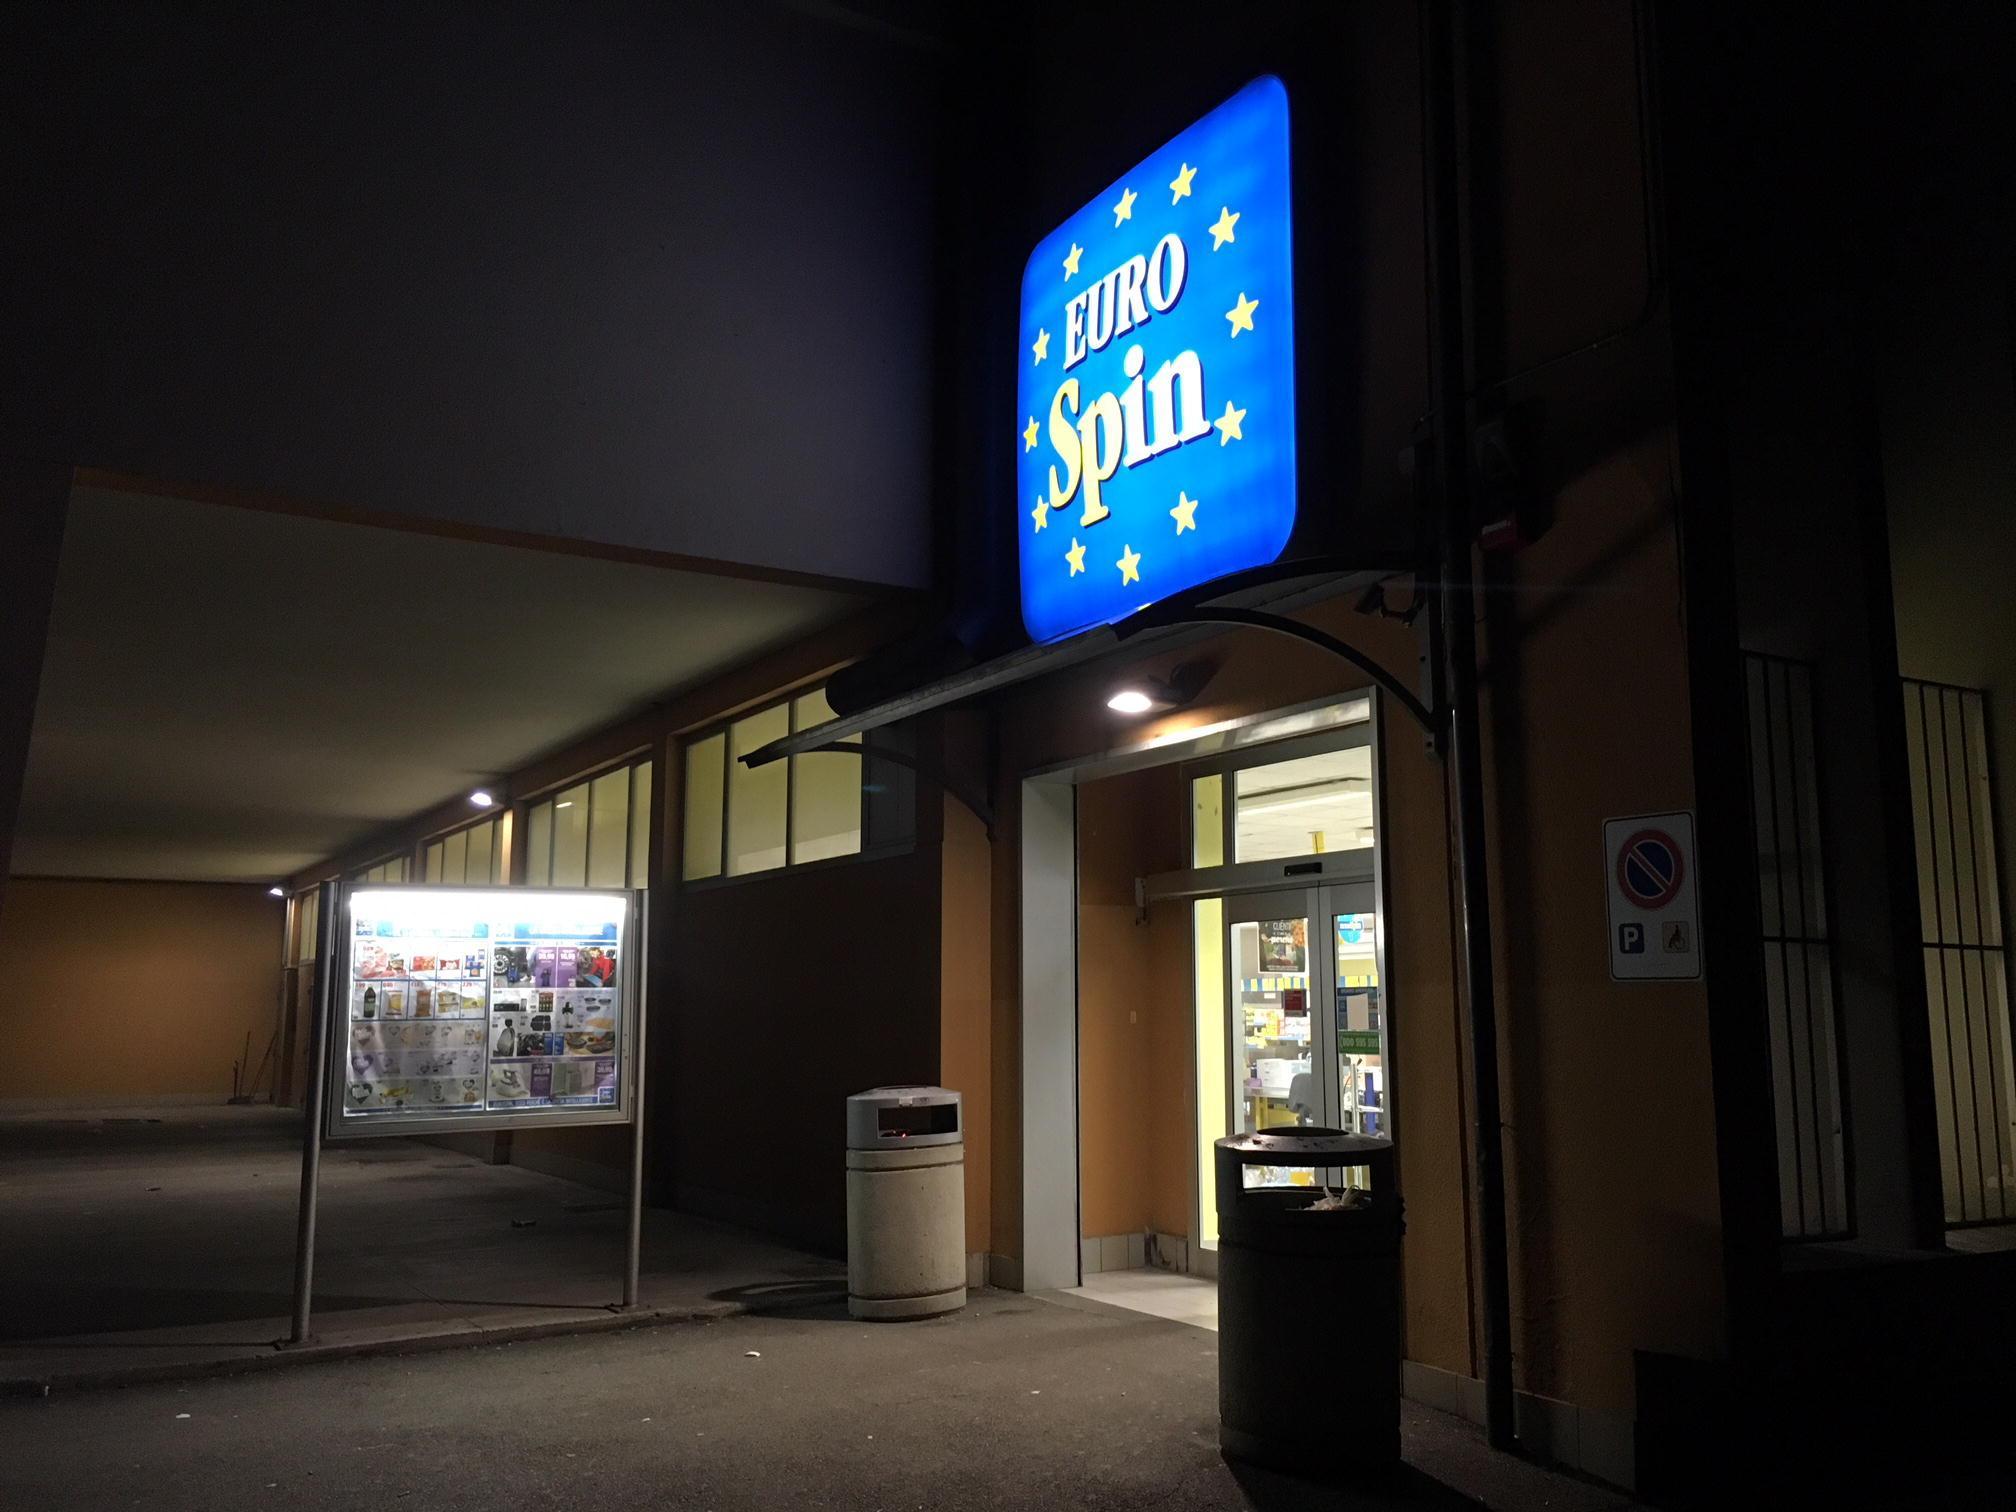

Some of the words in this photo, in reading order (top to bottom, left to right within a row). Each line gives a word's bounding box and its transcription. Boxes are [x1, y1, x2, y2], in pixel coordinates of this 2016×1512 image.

[1063, 233, 1187, 371] EURO
[1049, 344, 1213, 527] Spin
[1623, 926, 1640, 951] P
